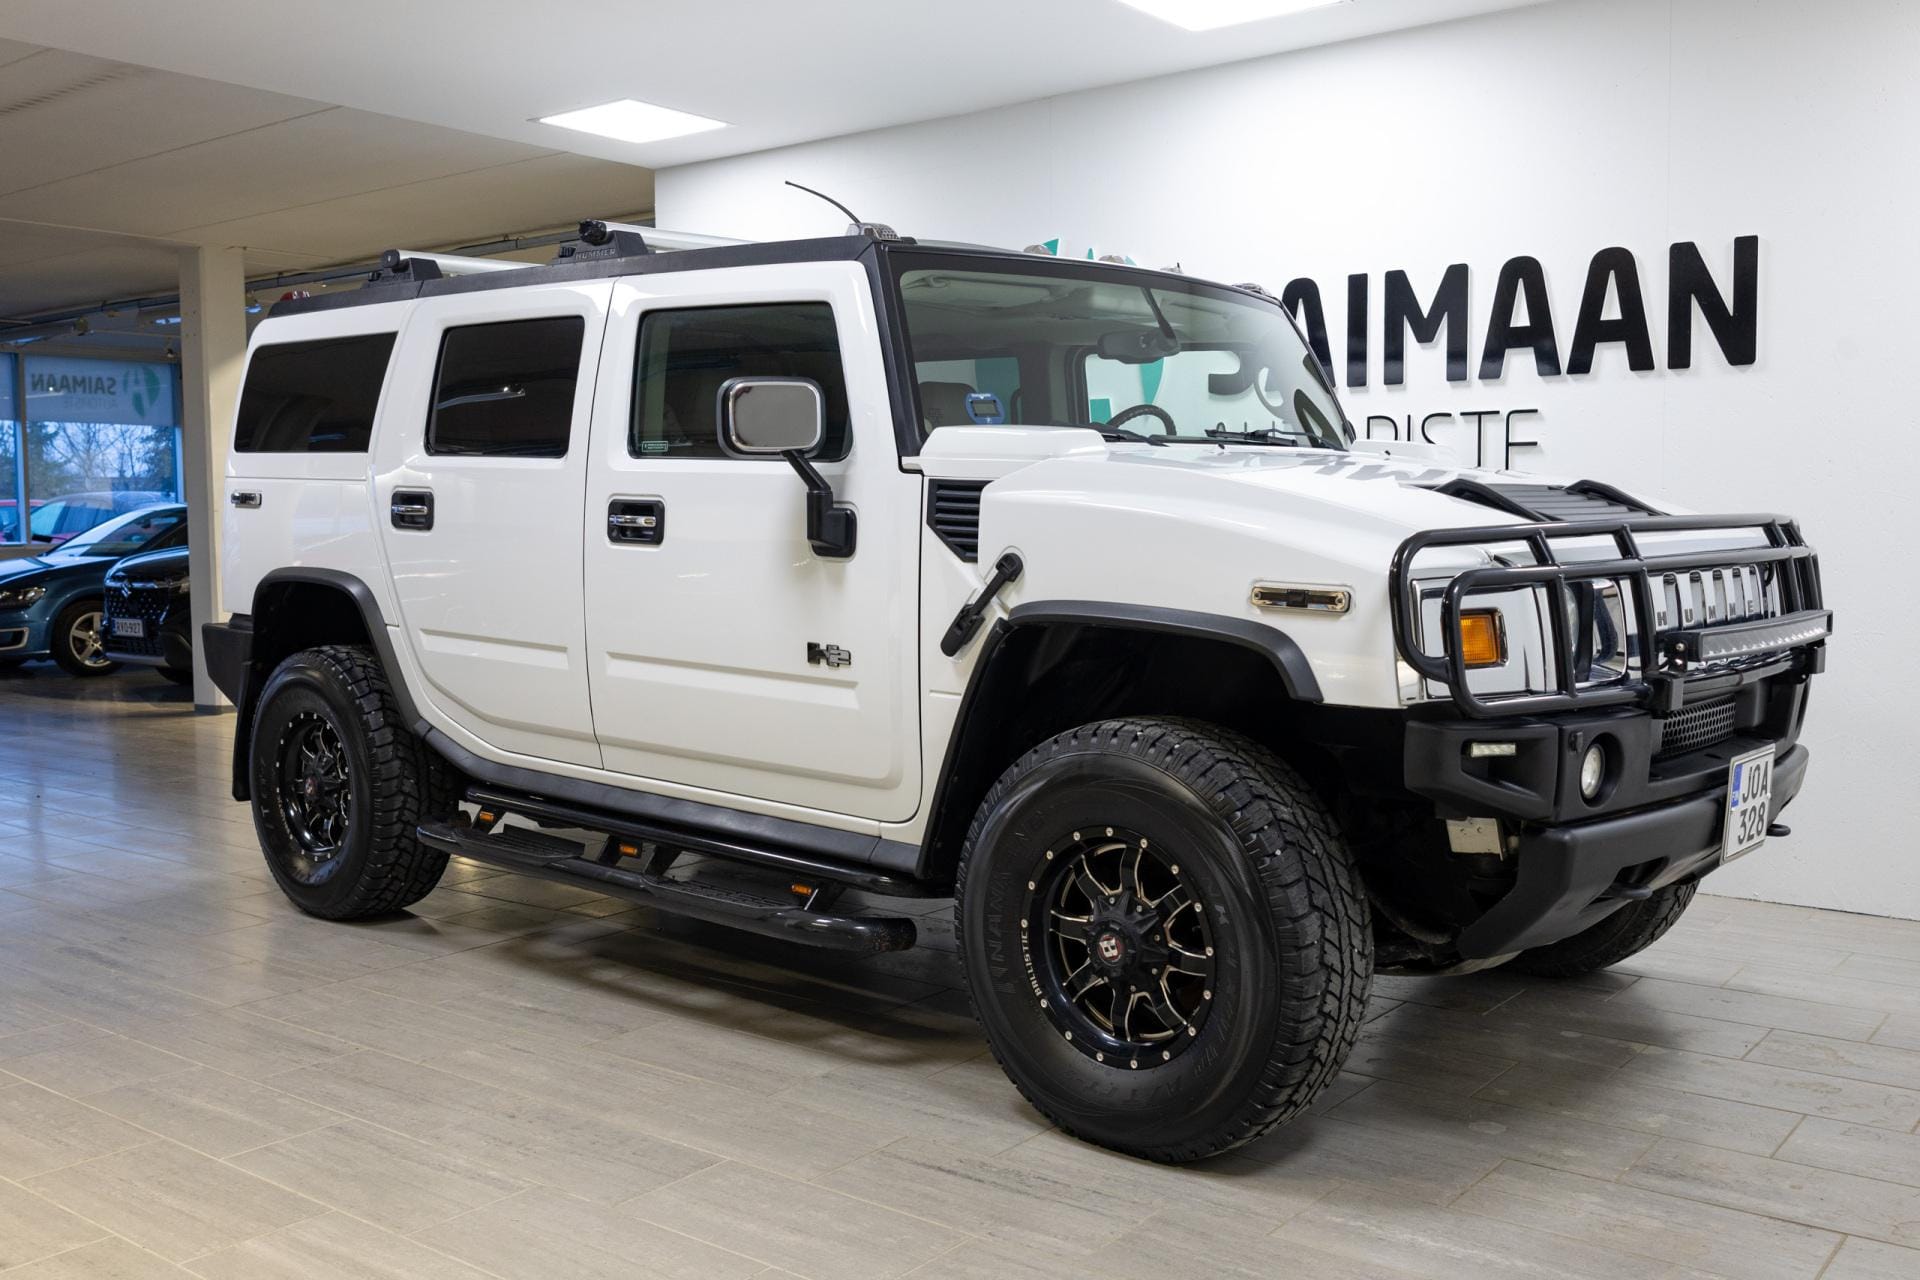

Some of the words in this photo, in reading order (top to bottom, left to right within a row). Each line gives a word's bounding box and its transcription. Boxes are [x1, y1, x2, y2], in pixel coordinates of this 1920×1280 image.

[575, 247, 616, 260] HUMMER
[1656, 600, 1755, 627] HUMME
[1742, 760, 1769, 803] JOA
[1737, 801, 1766, 845] 328
[1021, 930, 1042, 997] BALLISTIC
